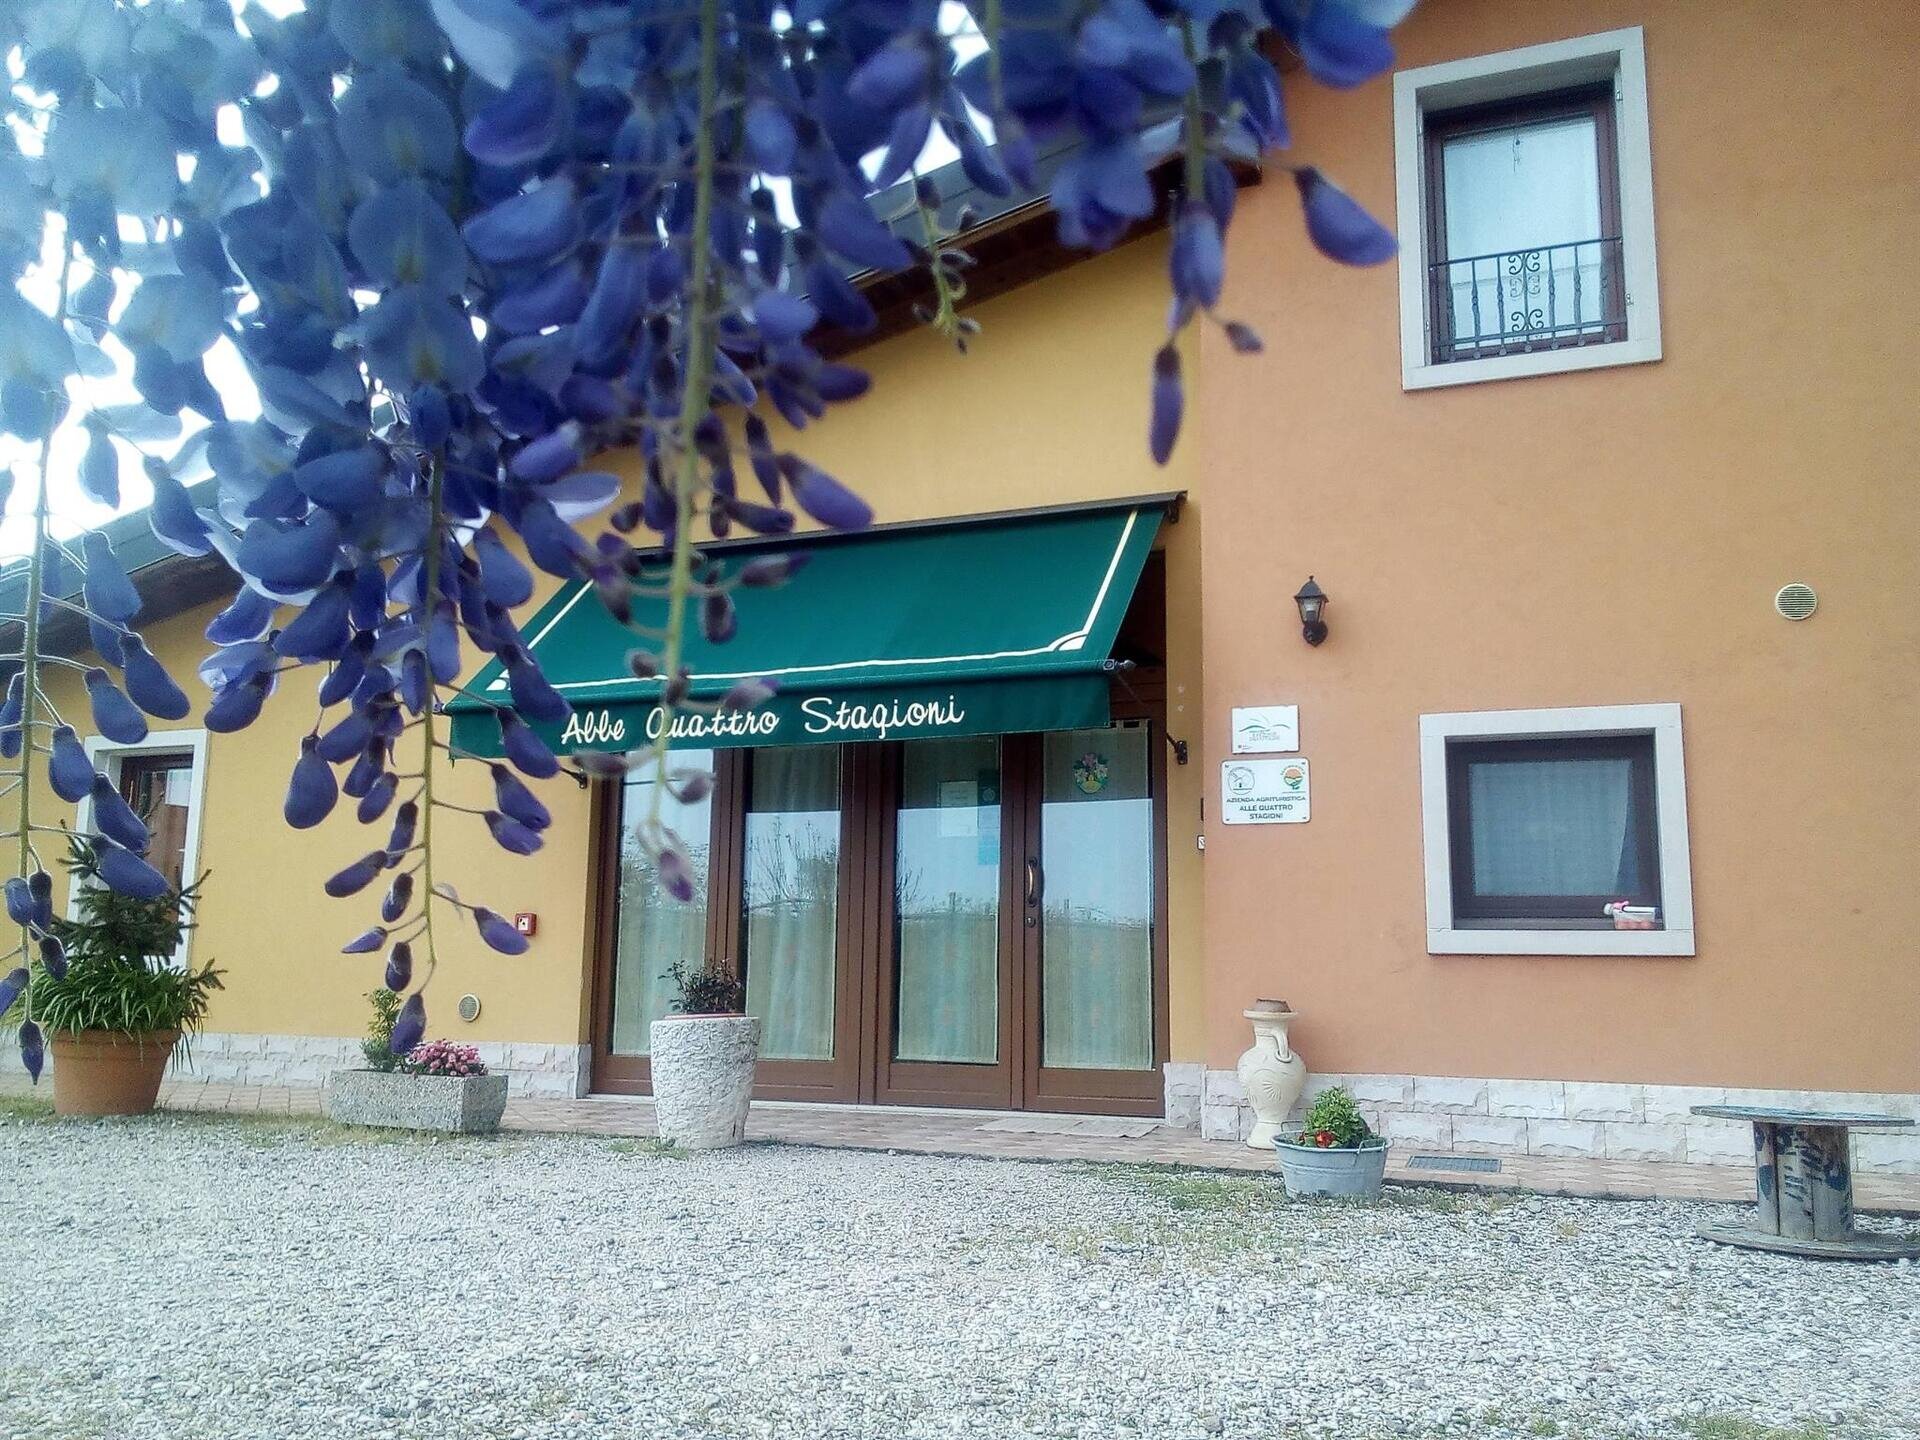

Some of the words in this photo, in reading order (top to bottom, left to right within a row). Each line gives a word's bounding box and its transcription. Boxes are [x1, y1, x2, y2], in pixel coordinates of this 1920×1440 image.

[645, 706, 780, 739] Quattro
[801, 695, 965, 740] Stagioni
[1239, 804, 1258, 812] ALLE
[1258, 804, 1294, 812] QUATTRO
[1249, 812, 1284, 820] STAGIONI
